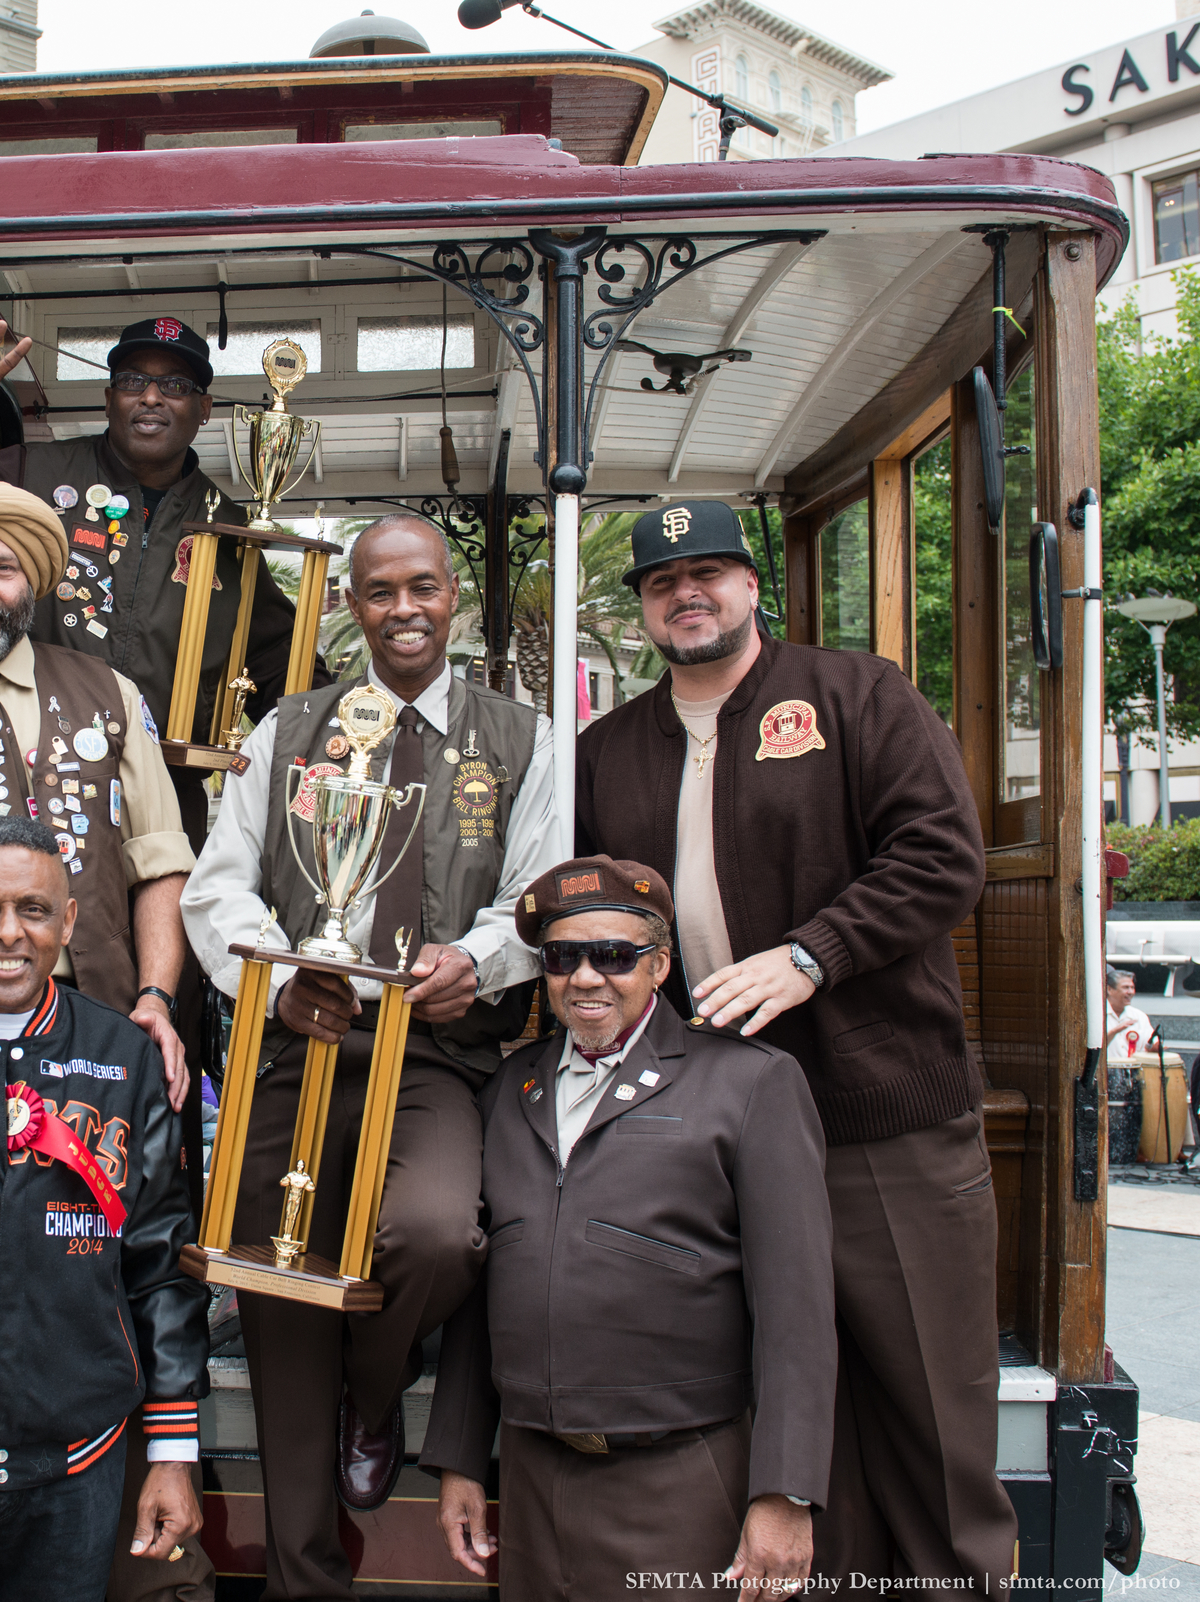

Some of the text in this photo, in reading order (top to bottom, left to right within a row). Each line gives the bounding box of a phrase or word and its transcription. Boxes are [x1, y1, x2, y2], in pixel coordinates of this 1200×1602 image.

[769, 727, 808, 742] RAILWAY
[459, 761, 488, 772] BYRON
[453, 769, 497, 787] CHAMPION
[452, 795, 499, 816] BELL RINGING
[461, 838, 479, 847] 2005
[63, 1059, 93, 1076] WORLD
[67, 1142, 112, 1205] JUDGE
[66, 1238, 103, 1255] 2014
